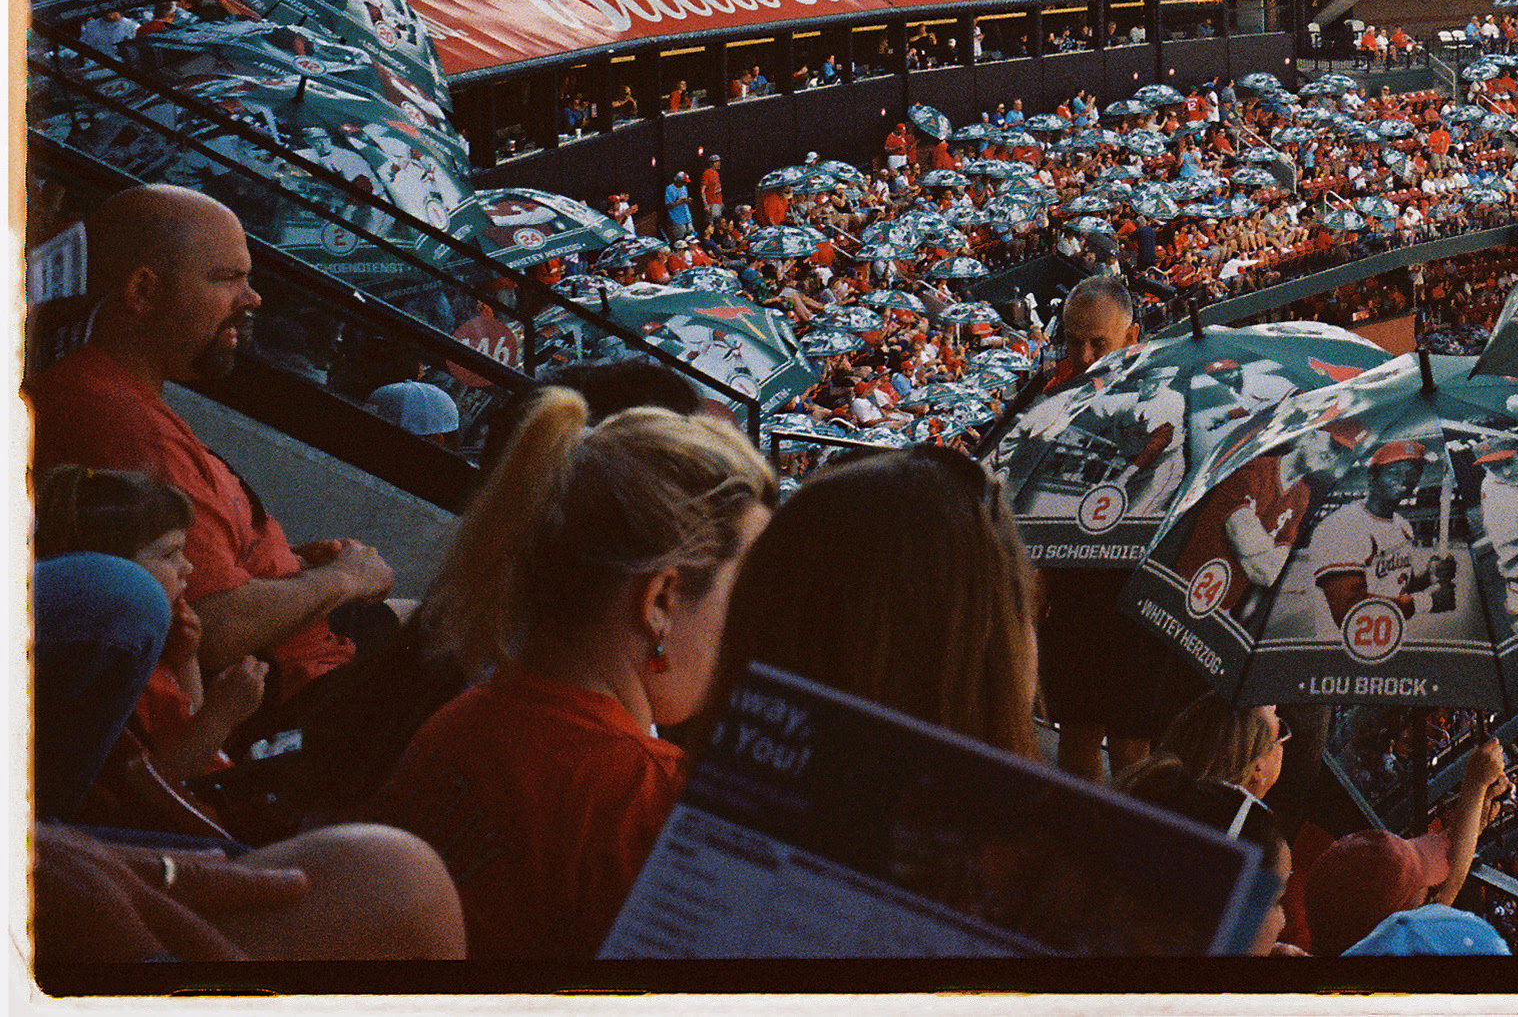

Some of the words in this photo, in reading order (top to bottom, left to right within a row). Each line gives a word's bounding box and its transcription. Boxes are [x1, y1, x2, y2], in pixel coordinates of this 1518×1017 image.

[334, 227, 346, 247] 2
[520, 232, 541, 245] 24
[1093, 496, 1111, 521] 2
[1193, 572, 1222, 606] 24
[1140, 598, 1185, 640] WHITEY
[1179, 629, 1223, 675] HERZOG
[1354, 615, 1393, 646] 20
[1309, 676, 1350, 696] LOU
[1355, 676, 1428, 697] BROCK
